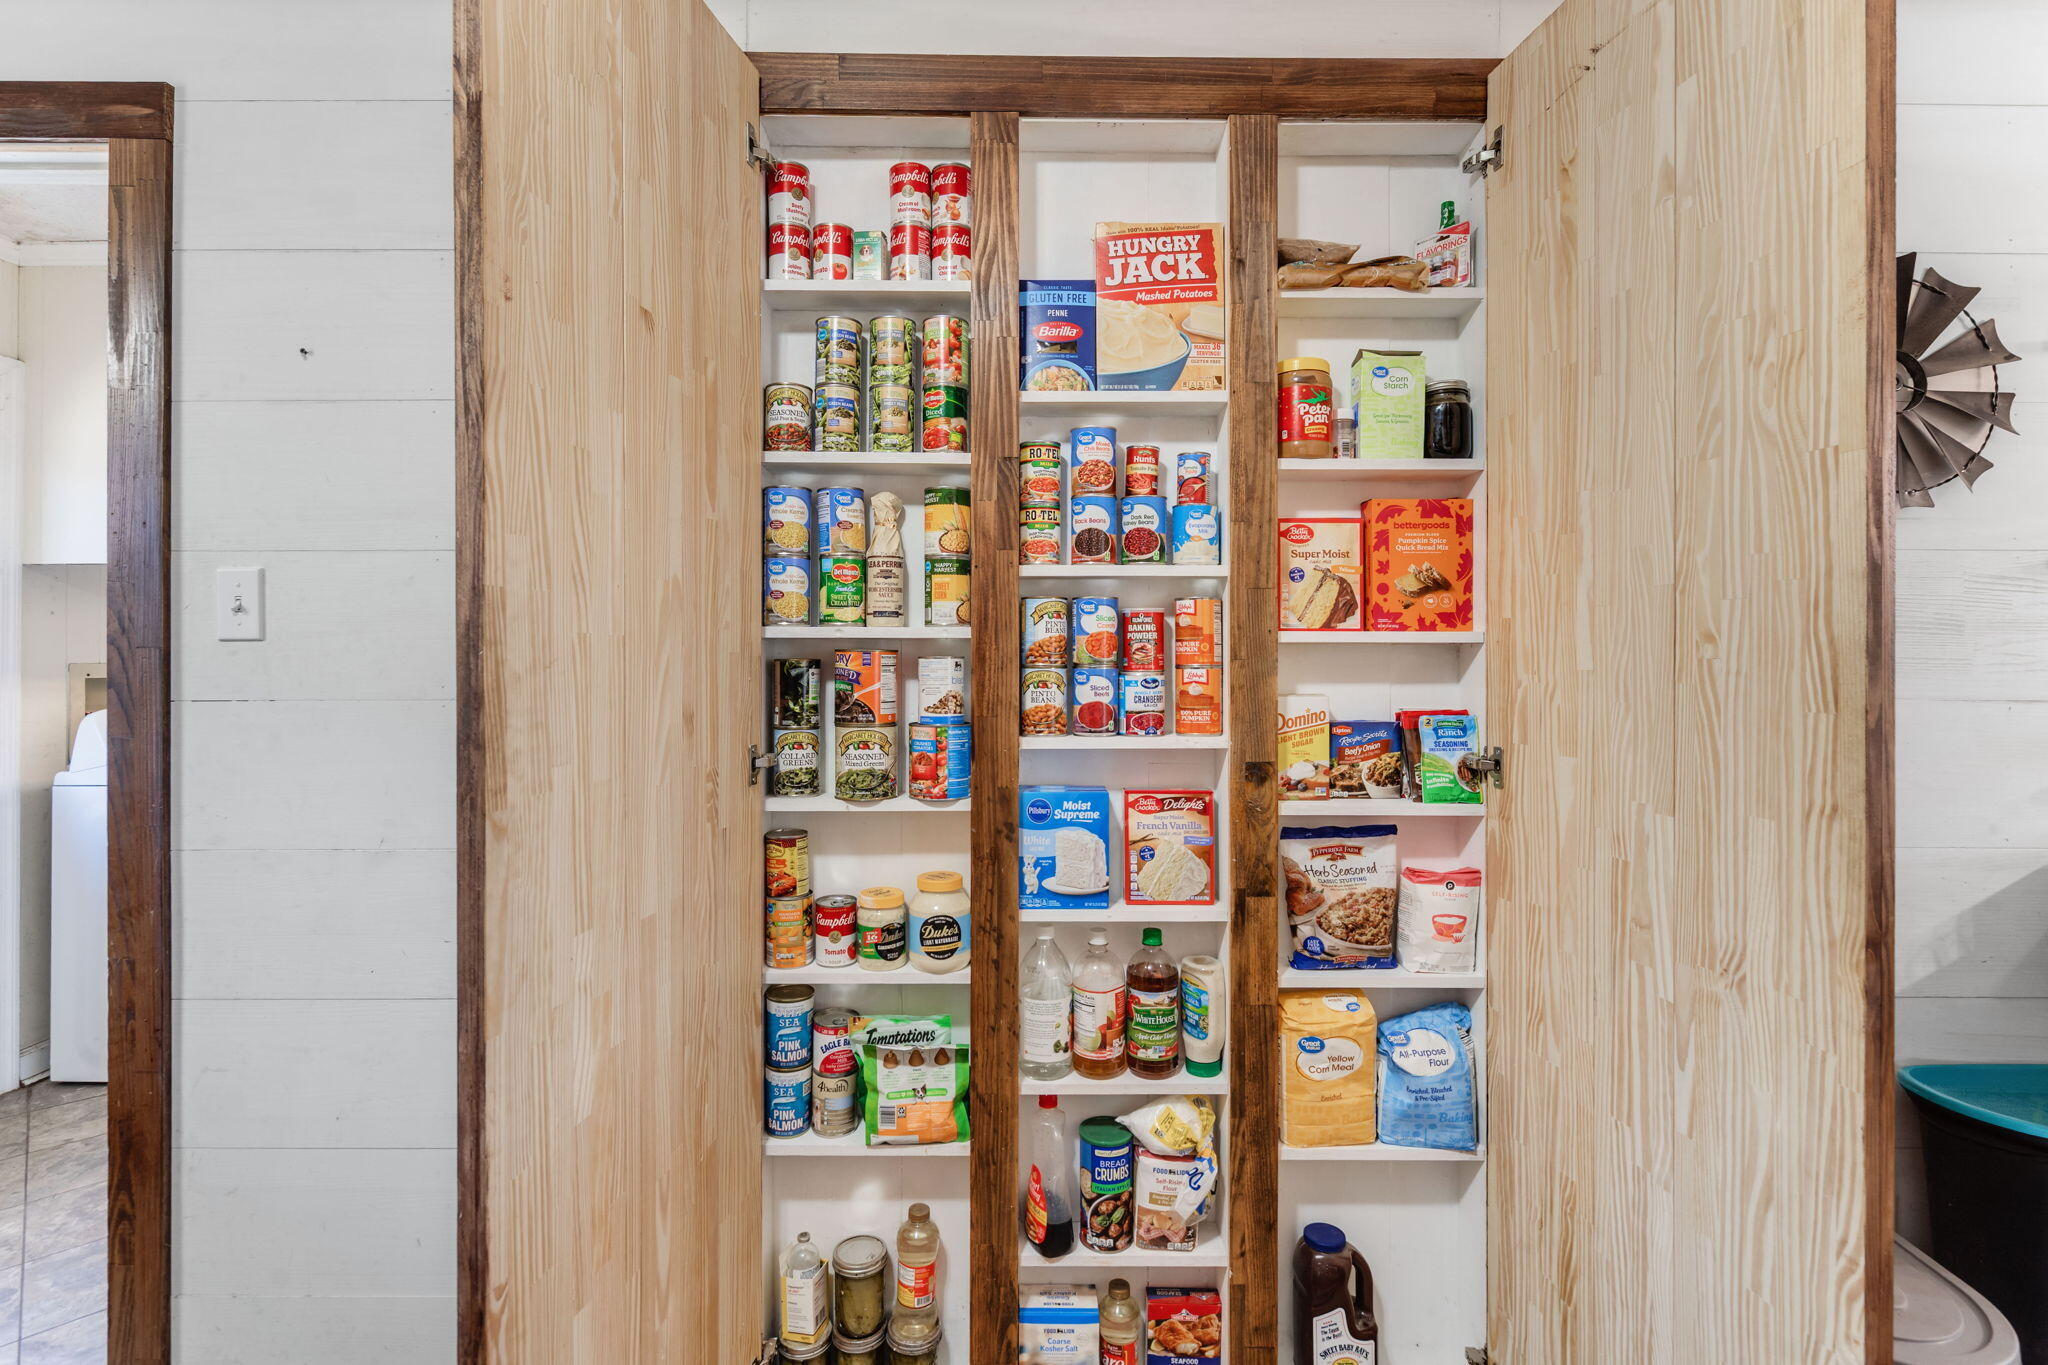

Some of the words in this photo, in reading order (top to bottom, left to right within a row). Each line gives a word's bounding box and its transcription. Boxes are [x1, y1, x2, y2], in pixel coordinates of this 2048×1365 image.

[1106, 234, 1201, 257] HUNGRY
[1415, 235, 1469, 260] FLAVORINGS
[1104, 252, 1206, 287] JACK
[1028, 293, 1063, 303] GLUTEN
[1066, 293, 1088, 304] FREE
[1135, 291, 1171, 302] Mashed
[1173, 288, 1214, 299] Potatoes
[1047, 309, 1069, 317] PENNE
[1038, 325, 1078, 337] Barilla
[1211, 342, 1222, 351] 36
[1388, 374, 1409, 383] Corn
[1383, 382, 1409, 390] Starch
[769, 408, 806, 419] SEASONED
[925, 409, 943, 417] Diced
[1297, 402, 1331, 416] Peter
[1393, 521, 1451, 531] bettergoods
[1397, 537, 1428, 545] Pumpkin
[1429, 537, 1448, 545] Spice
[1395, 543, 1415, 552] Quick
[1416, 543, 1436, 552] Bread
[1290, 548, 1321, 561] Super
[1322, 548, 1351, 559] Moist
[771, 577, 788, 585] Whole
[1095, 614, 1116, 622] Sliced
[1127, 623, 1157, 632] BAKING
[1126, 631, 1158, 640] POWDER
[1089, 684, 1110, 692] Sliced
[1030, 696, 1057, 704] BEANS
[1298, 726, 1326, 740] BROWN
[1437, 728, 1464, 737] Ranch
[1291, 737, 1314, 749] SUGAR
[1433, 740, 1469, 748] SEASONING
[1344, 745, 1363, 756] Beefy
[1362, 741, 1381, 753] Onion
[780, 752, 816, 760] COLLARD
[844, 752, 885, 761] SEASONED
[782, 759, 814, 767] GREENS
[1062, 800, 1092, 811] Moist
[1162, 796, 1206, 812] Delights
[1027, 806, 1052, 816] Pillsbury
[1053, 809, 1101, 822] Supreme
[1135, 821, 1169, 831] French
[1169, 821, 1203, 830] Vanilla
[1022, 835, 1052, 846] White
[1303, 863, 1330, 878] Herb
[1329, 861, 1379, 878] Seasoned
[816, 912, 856, 930] Campbell's
[921, 924, 960, 939] Duke's
[824, 948, 847, 957] Tomato
[779, 1018, 800, 1027] SEA
[778, 1040, 801, 1051] PINK
[820, 1038, 842, 1055] EAGLE
[771, 1048, 808, 1062] SALMON
[1398, 1047, 1447, 1059] All-Purpose
[1327, 1055, 1356, 1063] Yellow
[1428, 1058, 1450, 1068] Flour
[1331, 1063, 1355, 1072] Meal
[773, 1087, 795, 1097] SEA
[773, 1109, 796, 1120] PINK
[768, 1117, 804, 1132] SALMON
[1099, 1158, 1127, 1169] BREAD
[1094, 1164, 1130, 1182] CRUMBS
[1152, 1167, 1169, 1175] FOOD
[1046, 1337, 1072, 1345] Coarse
[1040, 1344, 1064, 1353] Kosher
[1064, 1344, 1079, 1353] Salt
[1319, 1345, 1339, 1361] SWEET
[1338, 1343, 1354, 1352] BABY
[1354, 1345, 1370, 1361] RAY'S
[1170, 1357, 1199, 1365] SEAFOOD
